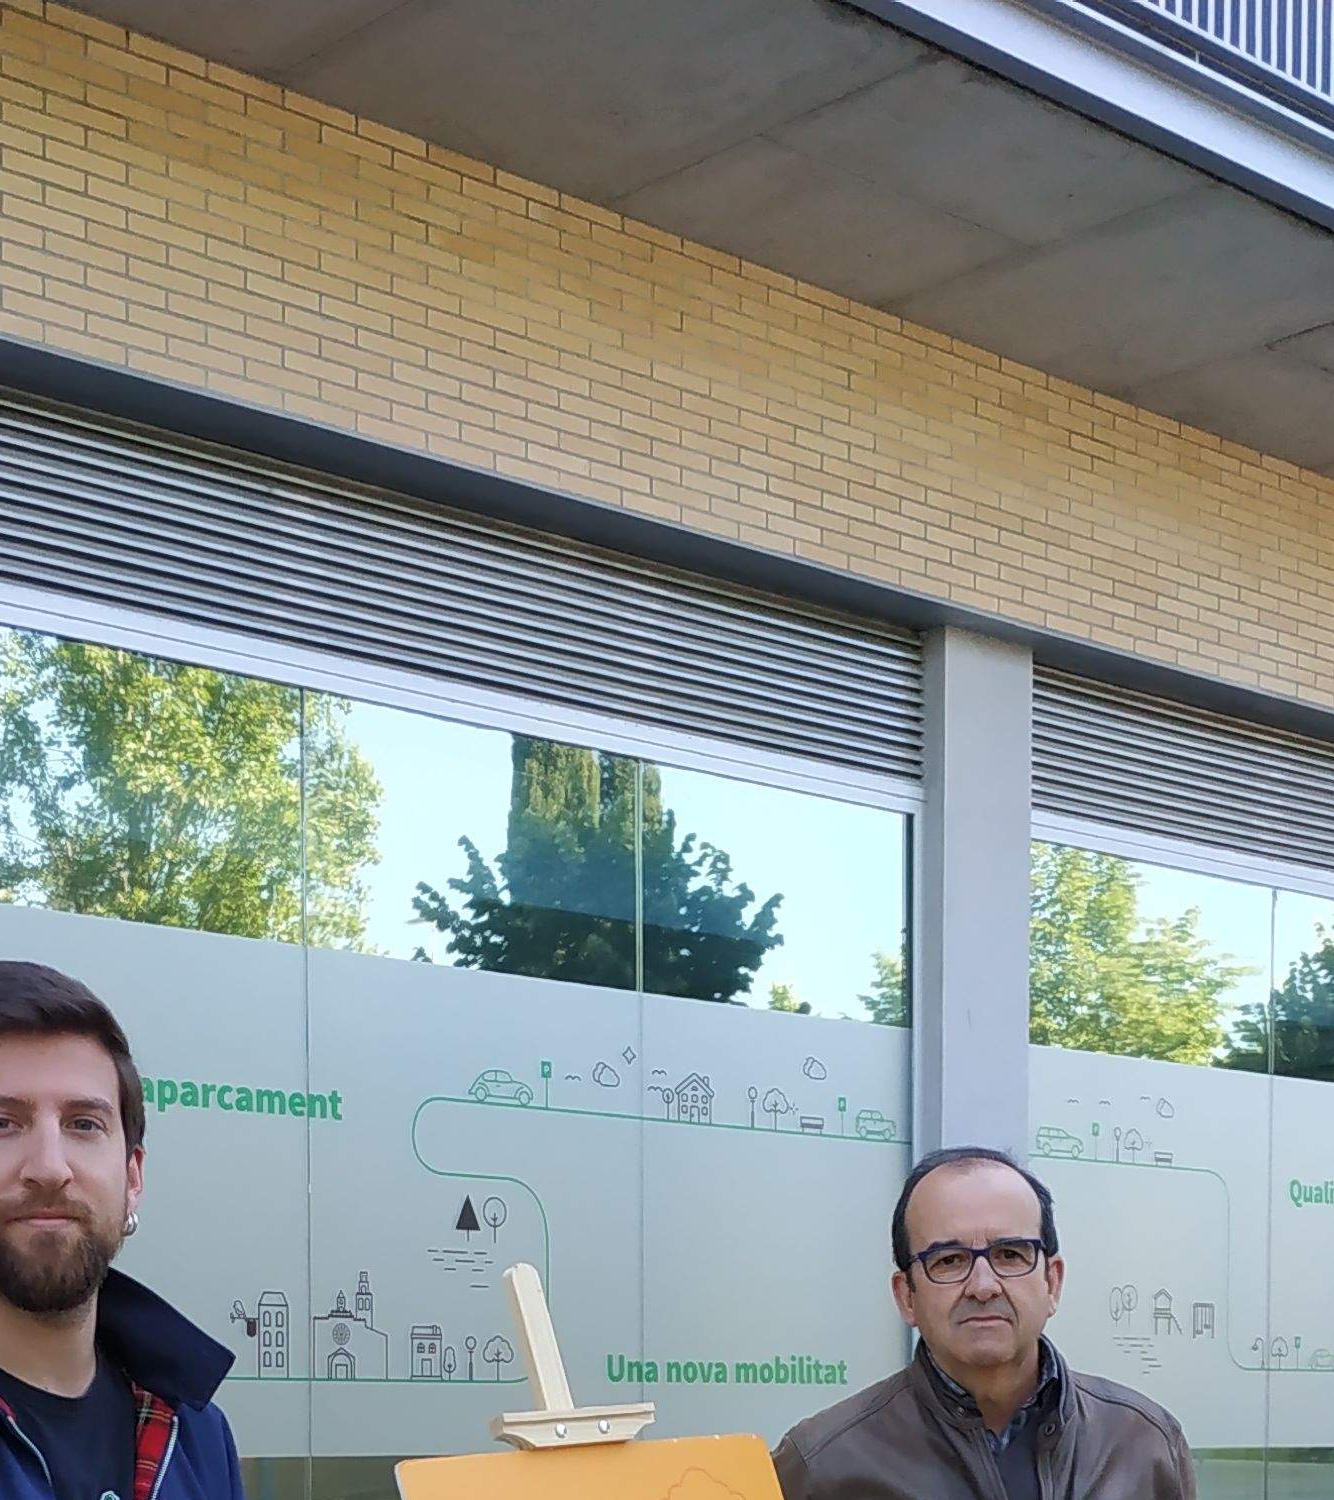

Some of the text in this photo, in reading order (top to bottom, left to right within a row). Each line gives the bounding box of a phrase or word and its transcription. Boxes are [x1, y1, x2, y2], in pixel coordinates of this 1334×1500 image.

[140, 1076, 343, 1121] aparcament
[606, 1354, 848, 1385] Una nova mobilitat
